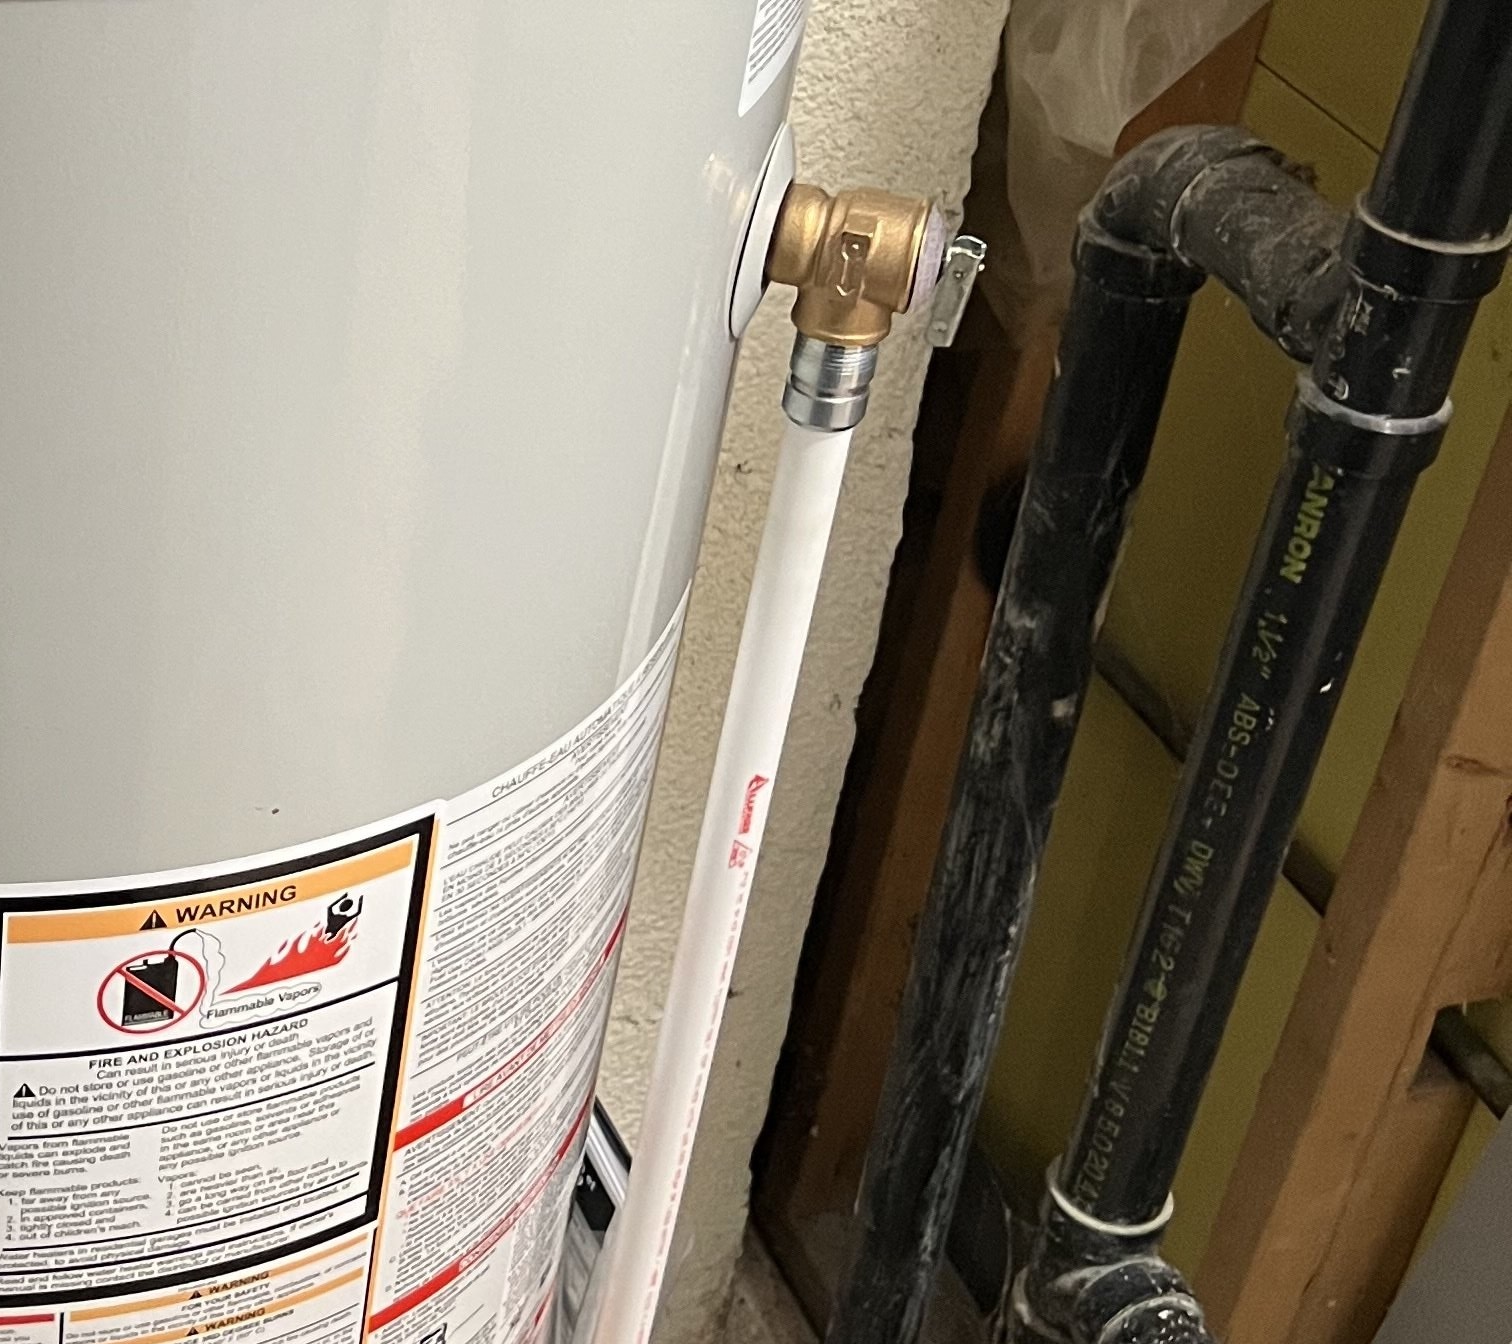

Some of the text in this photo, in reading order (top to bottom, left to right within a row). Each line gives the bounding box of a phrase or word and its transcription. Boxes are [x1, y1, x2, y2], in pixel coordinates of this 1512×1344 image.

[176, 885, 297, 923] WARNING
[206, 984, 319, 1019] Flammable Vapors
[39, 1016, 373, 1096] Do not store or use gasoline or other flammable vapors and
[89, 1018, 309, 1069] FIRE AND EXPLOSION HAZARD
[97, 1069, 121, 1079] Can
[125, 1064, 158, 1076] result
[161, 1062, 171, 1070] in
[175, 1053, 217, 1068] serious
[220, 1047, 251, 1059] injury
[254, 1043, 265, 1051] or
[12, 1099, 52, 1110] liquids
[55, 1096, 66, 1105] in
[70, 1094, 88, 1103] the
[92, 1089, 133, 1101] vicinity
[136, 1087, 148, 1097] of
[151, 1084, 172, 1095] this
[175, 1081, 187, 1090] or
[189, 1074, 210, 1088] any
[214, 1069, 247, 1082] other
[309, 1038, 349, 1057] Storage
[352, 1033, 362, 1043] of
[12, 1038, 377, 1120] use of gasoline or other flammable vapors or liquids in the vicinity
[11, 1121, 23, 1131] of
[26, 1119, 48, 1130] this
[51, 1118, 64, 1128] or
[68, 1116, 89, 1127] any
[92, 1113, 124, 1125] other
[127, 1105, 183, 1121] appliance
[187, 1097, 208, 1110] can
[210, 1091, 241, 1105] result
[245, 1087, 255, 1097] in
[258, 1078, 296, 1093] serious
[300, 1068, 328, 1082] injury
[331, 1062, 342, 1071] or
[38, 1150, 58, 1158] can
[62, 1146, 106, 1157] explode
[109, 1142, 130, 1151] and
[43, 1140, 69, 1148] from
[72, 1135, 130, 1146] flammable
[12, 1170, 50, 1178] severe
[32, 1160, 49, 1168] fire
[53, 1155, 96, 1166] causing
[100, 1151, 131, 1161] death
[208, 1271, 270, 1295] WARNING
[204, 1307, 266, 1331] WARNING
